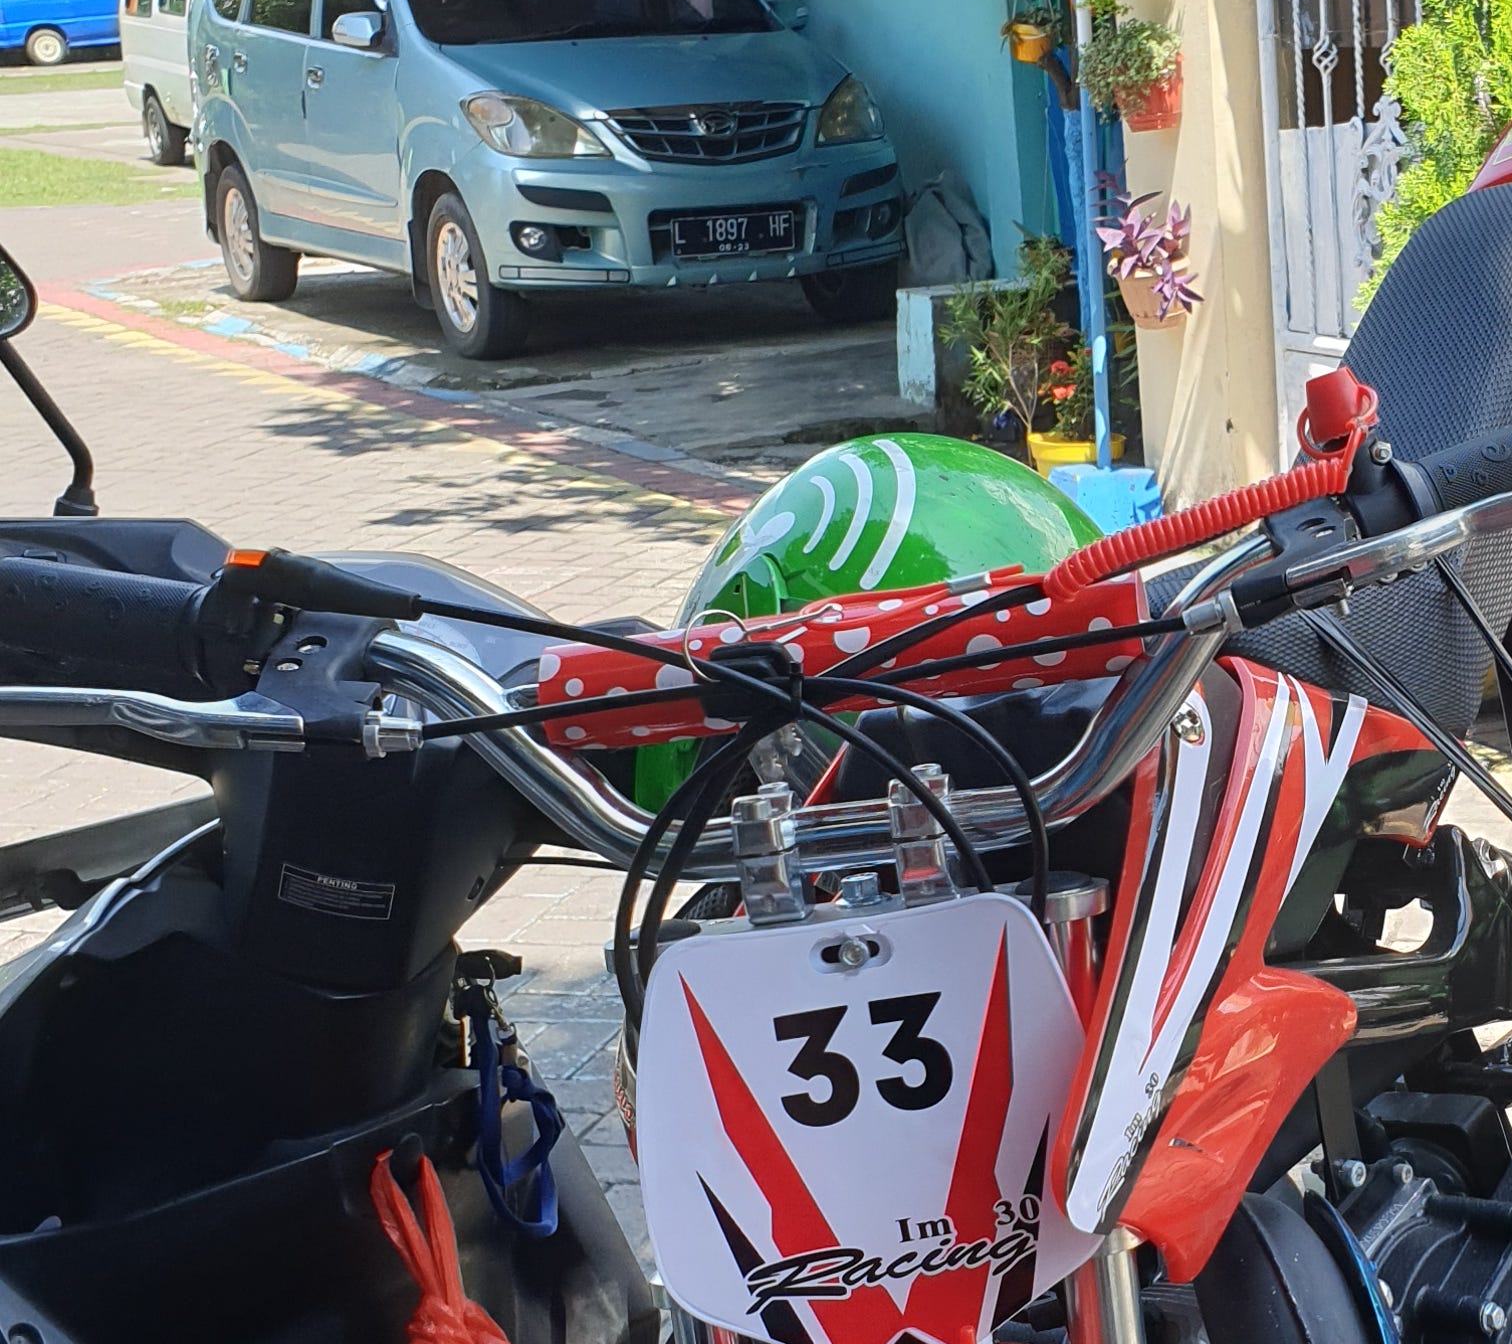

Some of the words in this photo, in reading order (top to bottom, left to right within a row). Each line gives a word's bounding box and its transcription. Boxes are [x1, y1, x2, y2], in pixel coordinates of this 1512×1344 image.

[675, 222, 687, 244] L
[706, 217, 748, 242] 1897
[769, 214, 790, 237] HF
[773, 991, 953, 1127] 33
[1096, 1088, 1162, 1224] Racing
[895, 1217, 954, 1243] Im
[993, 1199, 1040, 1226] 30
[744, 1231, 1037, 1315] Racing
